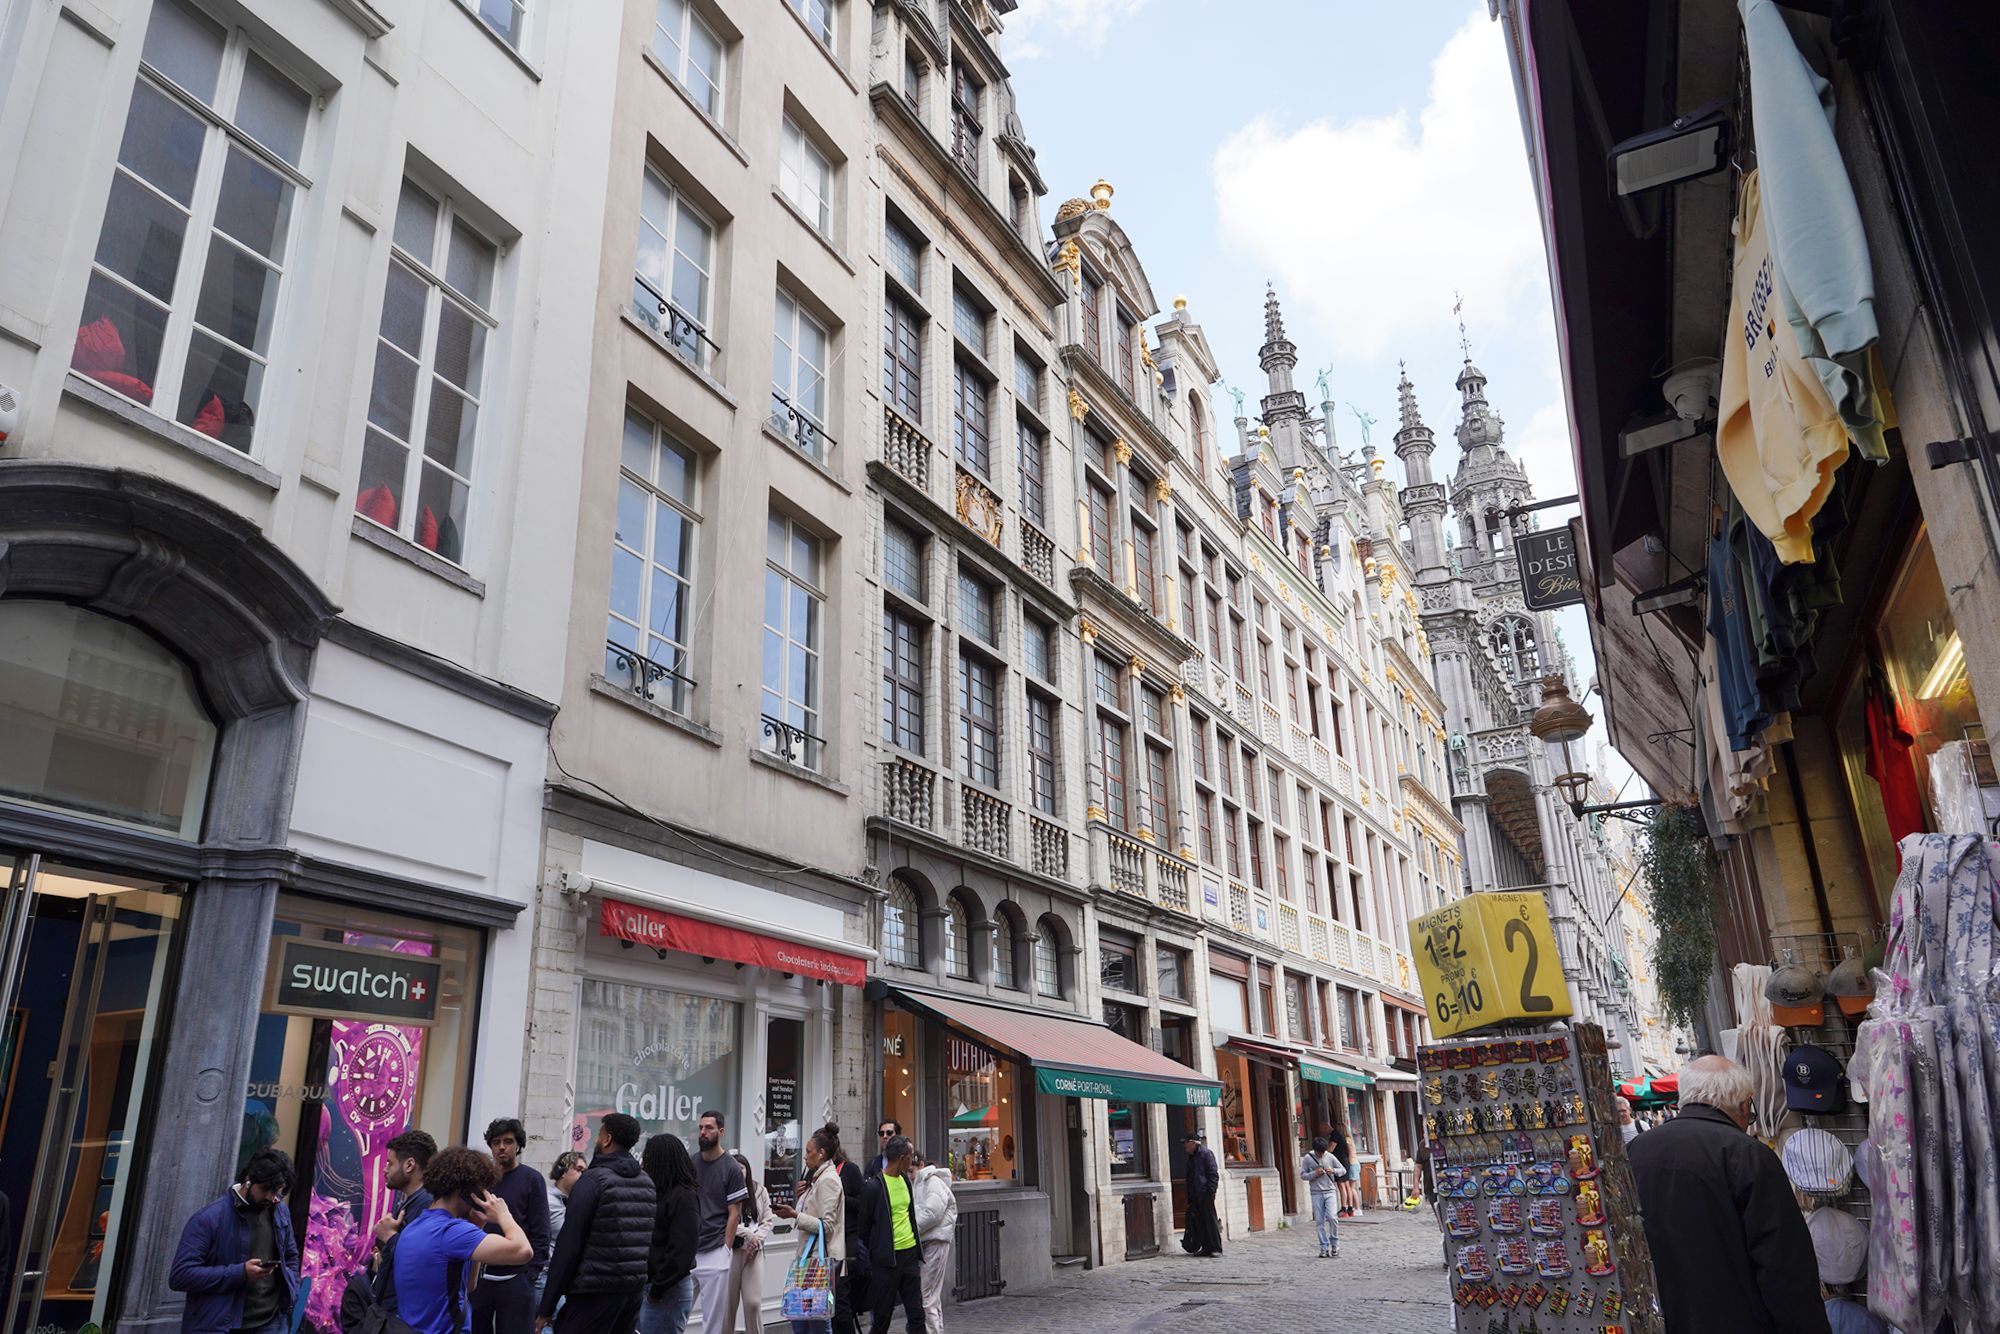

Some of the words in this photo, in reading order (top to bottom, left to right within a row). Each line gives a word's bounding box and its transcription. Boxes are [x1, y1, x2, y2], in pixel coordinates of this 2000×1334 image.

[1546, 536, 1568, 552] LE
[1491, 894, 1528, 902] MAGNETS
[1418, 906, 1460, 934] MAGNETS
[1519, 905, 1530, 921] €
[1504, 918, 1554, 1013] 2
[291, 964, 408, 1000] swatch
[1440, 968, 1466, 985] PROMO
[634, 1039, 690, 1071] chocolaterie
[1055, 1078, 1077, 1092] CORNÉ
[1077, 1082, 1114, 1095] PORT-ROYAL
[615, 1082, 703, 1121] Galler
[1185, 1087, 1212, 1106] NEUHAUS
